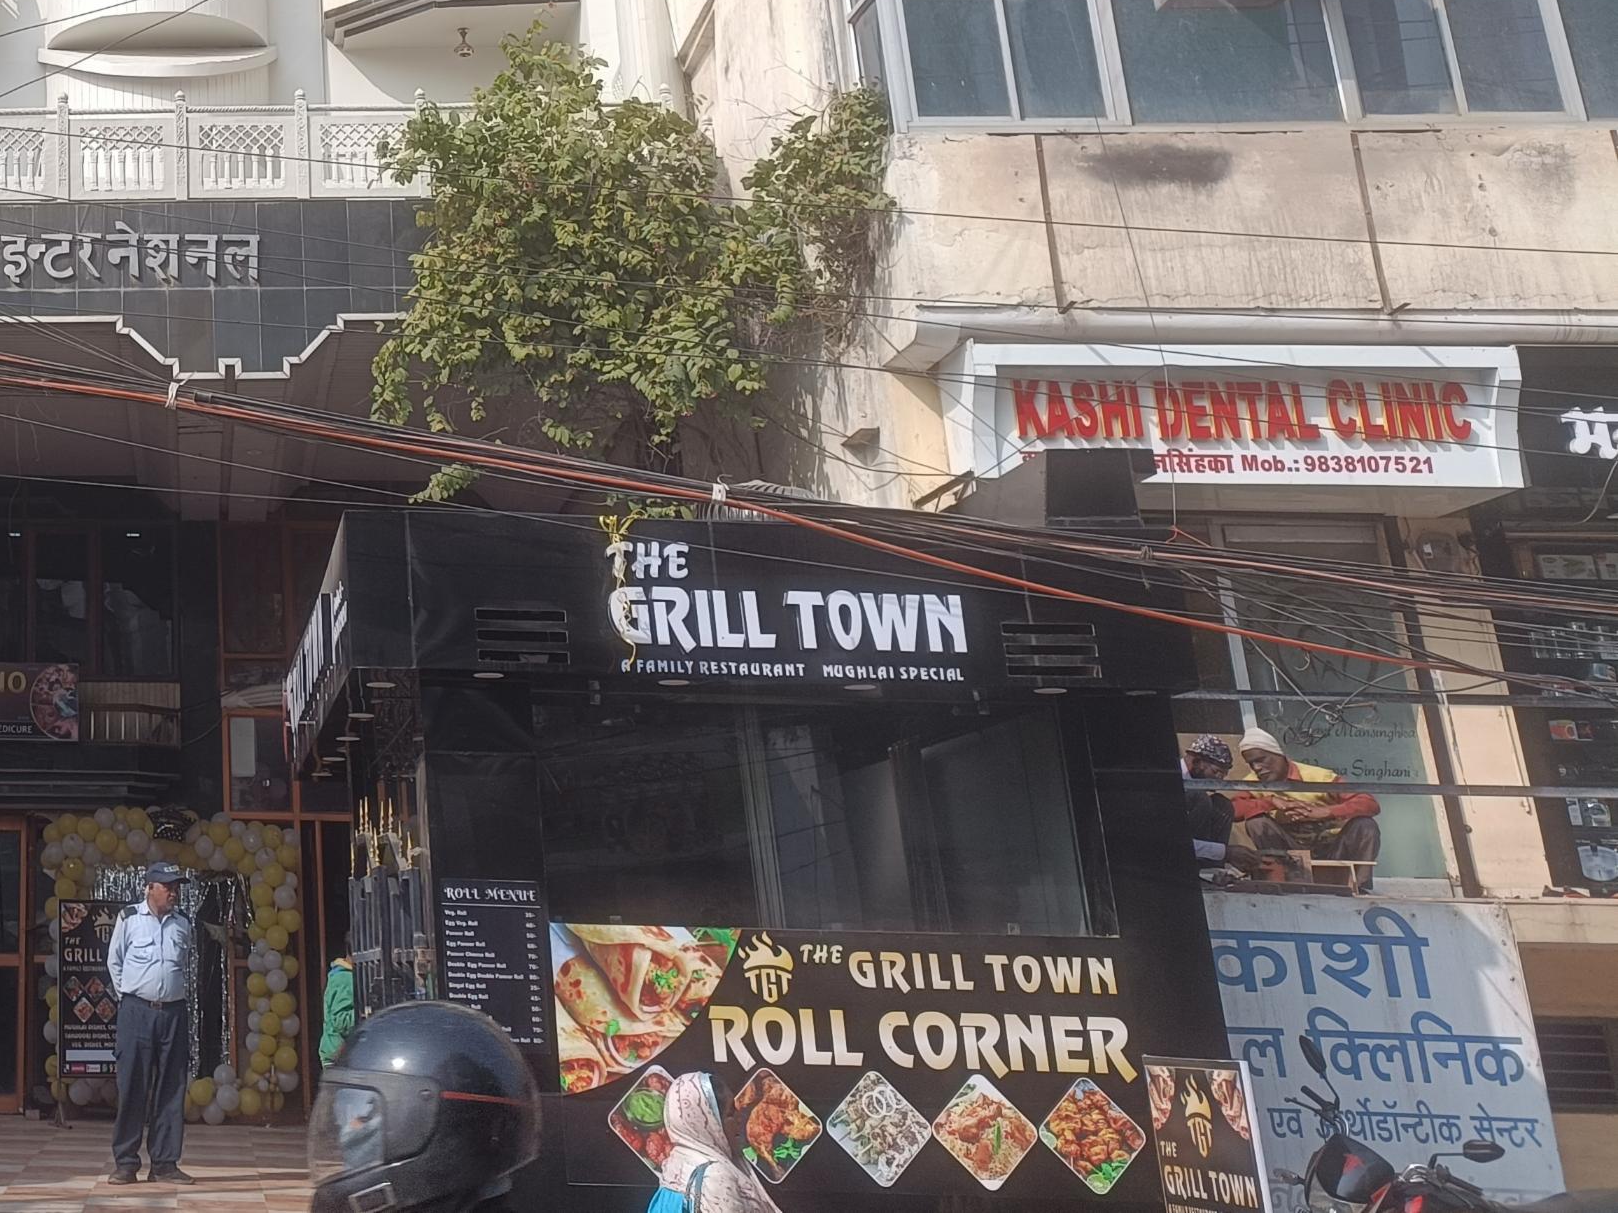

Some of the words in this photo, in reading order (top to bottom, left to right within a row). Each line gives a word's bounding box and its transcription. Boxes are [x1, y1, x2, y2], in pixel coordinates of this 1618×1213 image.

[1, 220, 260, 285] इन्टरनेशनल
[1011, 378, 1145, 442] KASHI
[1151, 378, 1322, 443] DENTAL
[1325, 378, 1473, 443] CLINIC
[1303, 455, 1434, 475] 9838107521
[605, 541, 689, 579] THE
[608, 586, 777, 654] GRILL
[784, 589, 969, 654] TOWN
[621, 659, 632, 673] A
[636, 659, 694, 675] FAMILY
[699, 660, 806, 678] RESTAURANT
[822, 664, 895, 680] MUGHLAI
[899, 666, 965, 682] SPECIAL
[444, 887, 481, 901] ROLL
[64, 948, 103, 963] GRILL
[65, 936, 81, 945] THE
[1209, 907, 1431, 1000] काशी
[744, 968, 792, 1004] TGT
[799, 943, 844, 965] THE
[848, 950, 975, 995] GRILL
[984, 954, 1119, 996] TOWN
[708, 1005, 865, 1072] ROLL
[878, 1010, 1139, 1084] CORNER
[1160, 1140, 1178, 1158] THE
[1187, 1117, 1213, 1158] TGT
[1164, 1165, 1208, 1201] GRILL
[1209, 1170, 1259, 1209] TOWN
